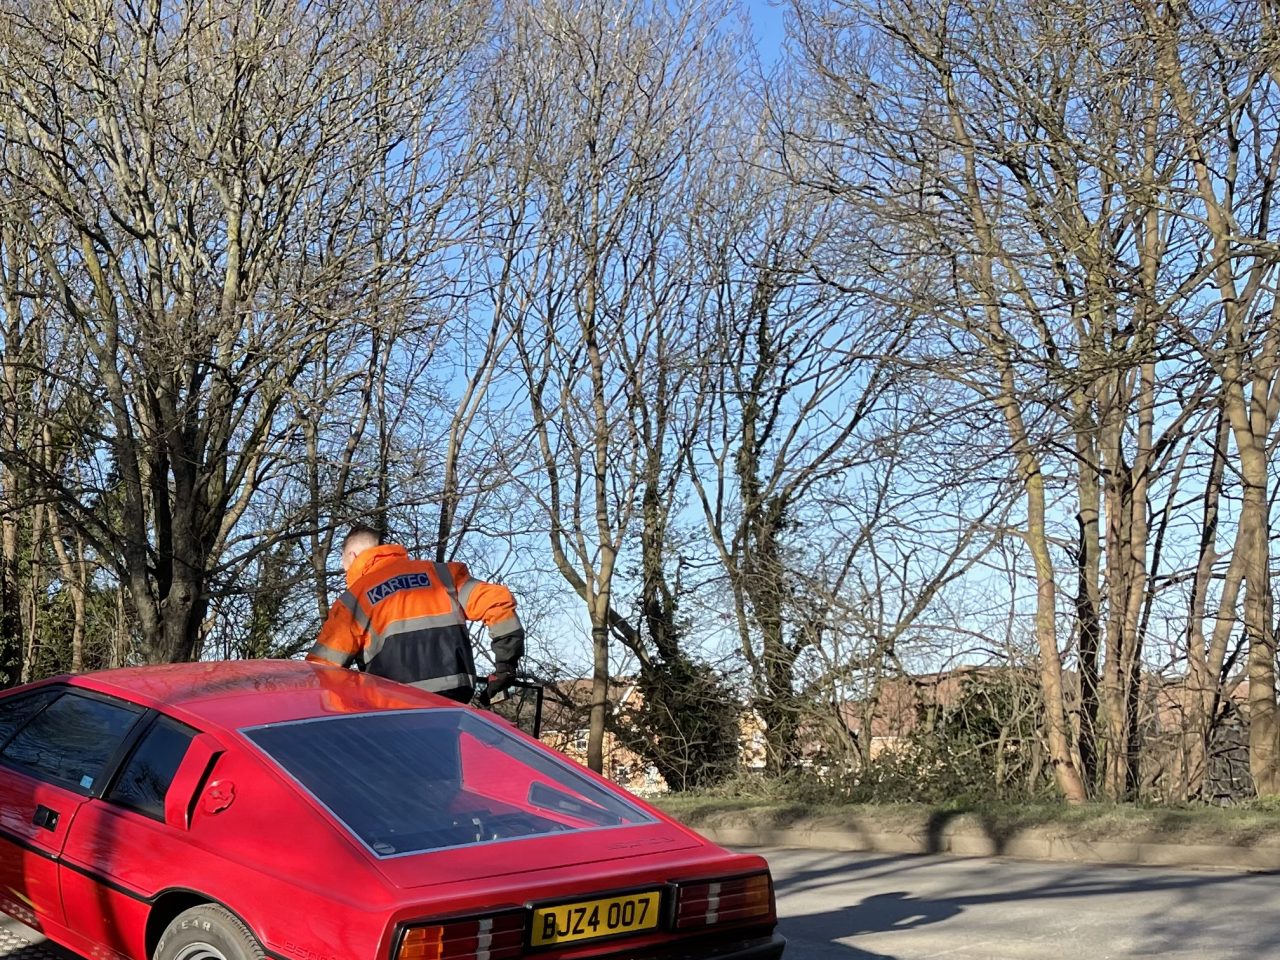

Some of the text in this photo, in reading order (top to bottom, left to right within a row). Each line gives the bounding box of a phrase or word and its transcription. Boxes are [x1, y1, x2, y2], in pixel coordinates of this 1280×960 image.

[368, 574, 429, 603] KARTEC
[541, 898, 651, 940] BJZ4 007
